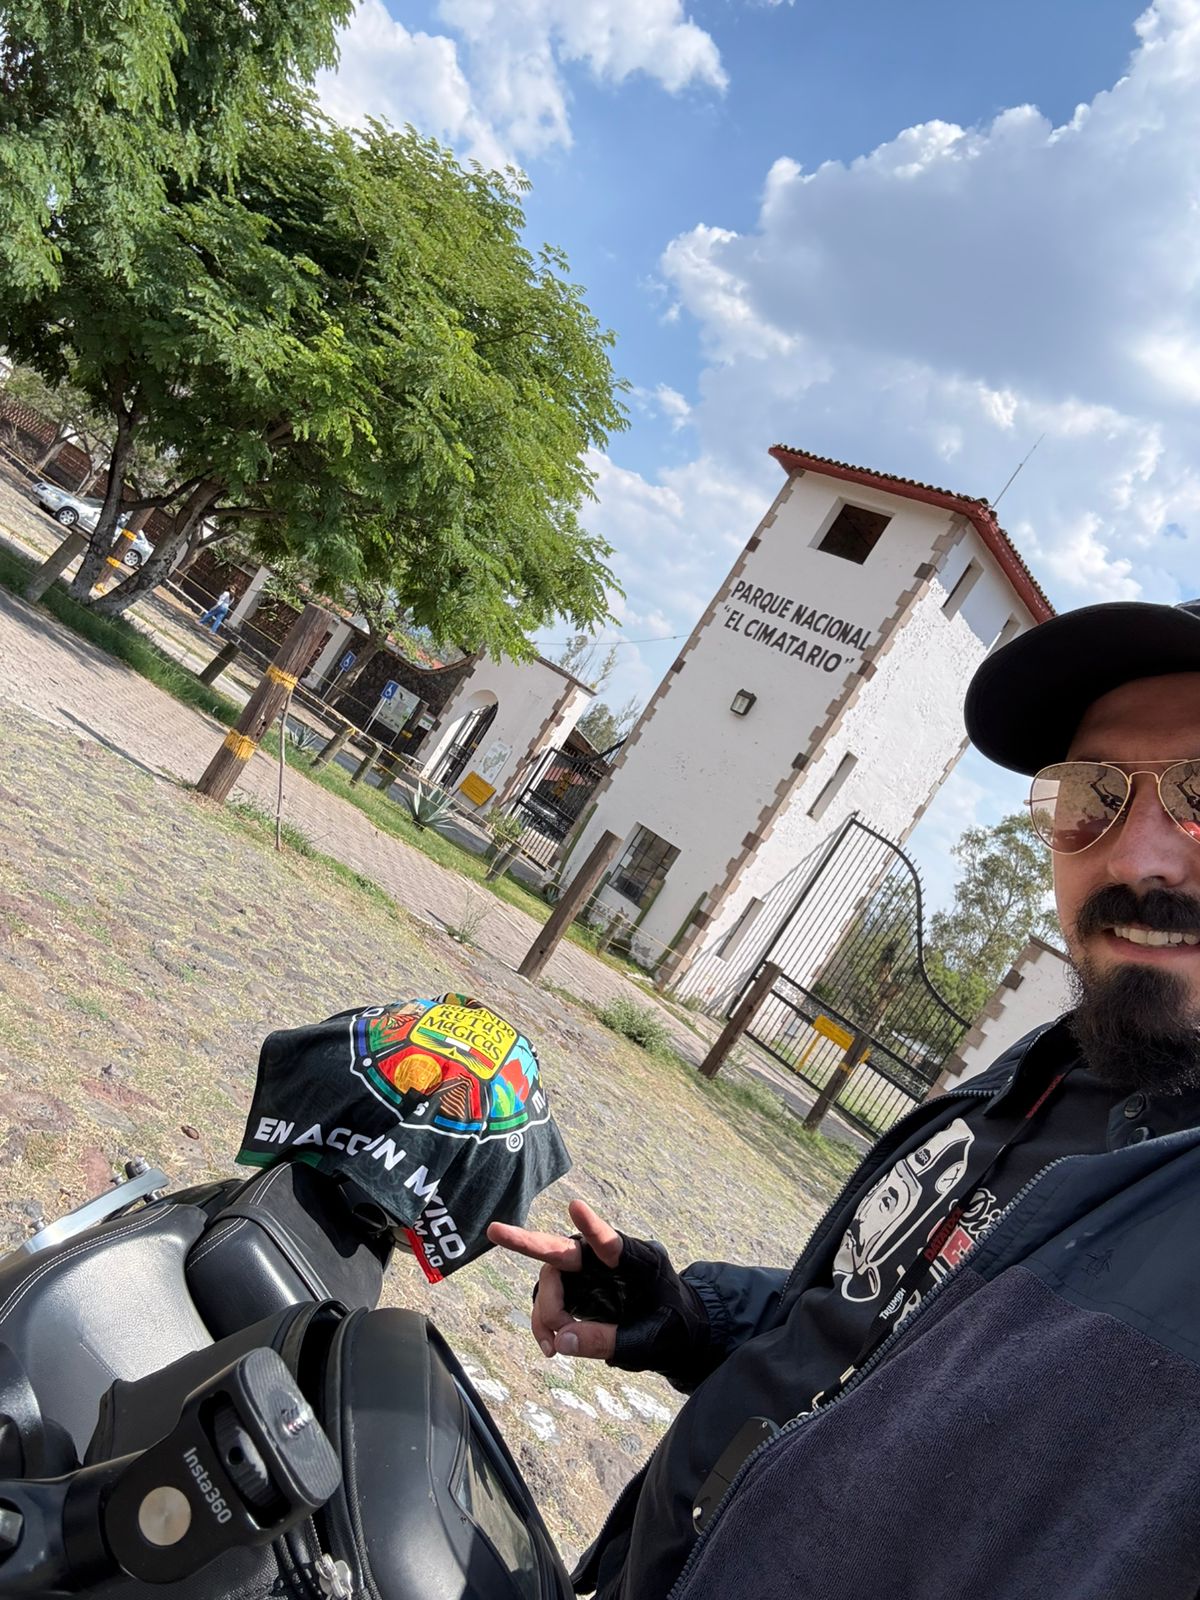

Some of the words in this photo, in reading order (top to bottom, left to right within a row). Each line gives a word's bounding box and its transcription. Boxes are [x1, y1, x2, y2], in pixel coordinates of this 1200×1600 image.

[731, 580, 794, 619] PARQUE
[790, 604, 872, 651] NACIONAL
[254, 1116, 295, 1145] EN
[422, 1242, 444, 1268] 4.0
[879, 1287, 907, 1320] TRIUMPH
[183, 1446, 233, 1524] Insta360
